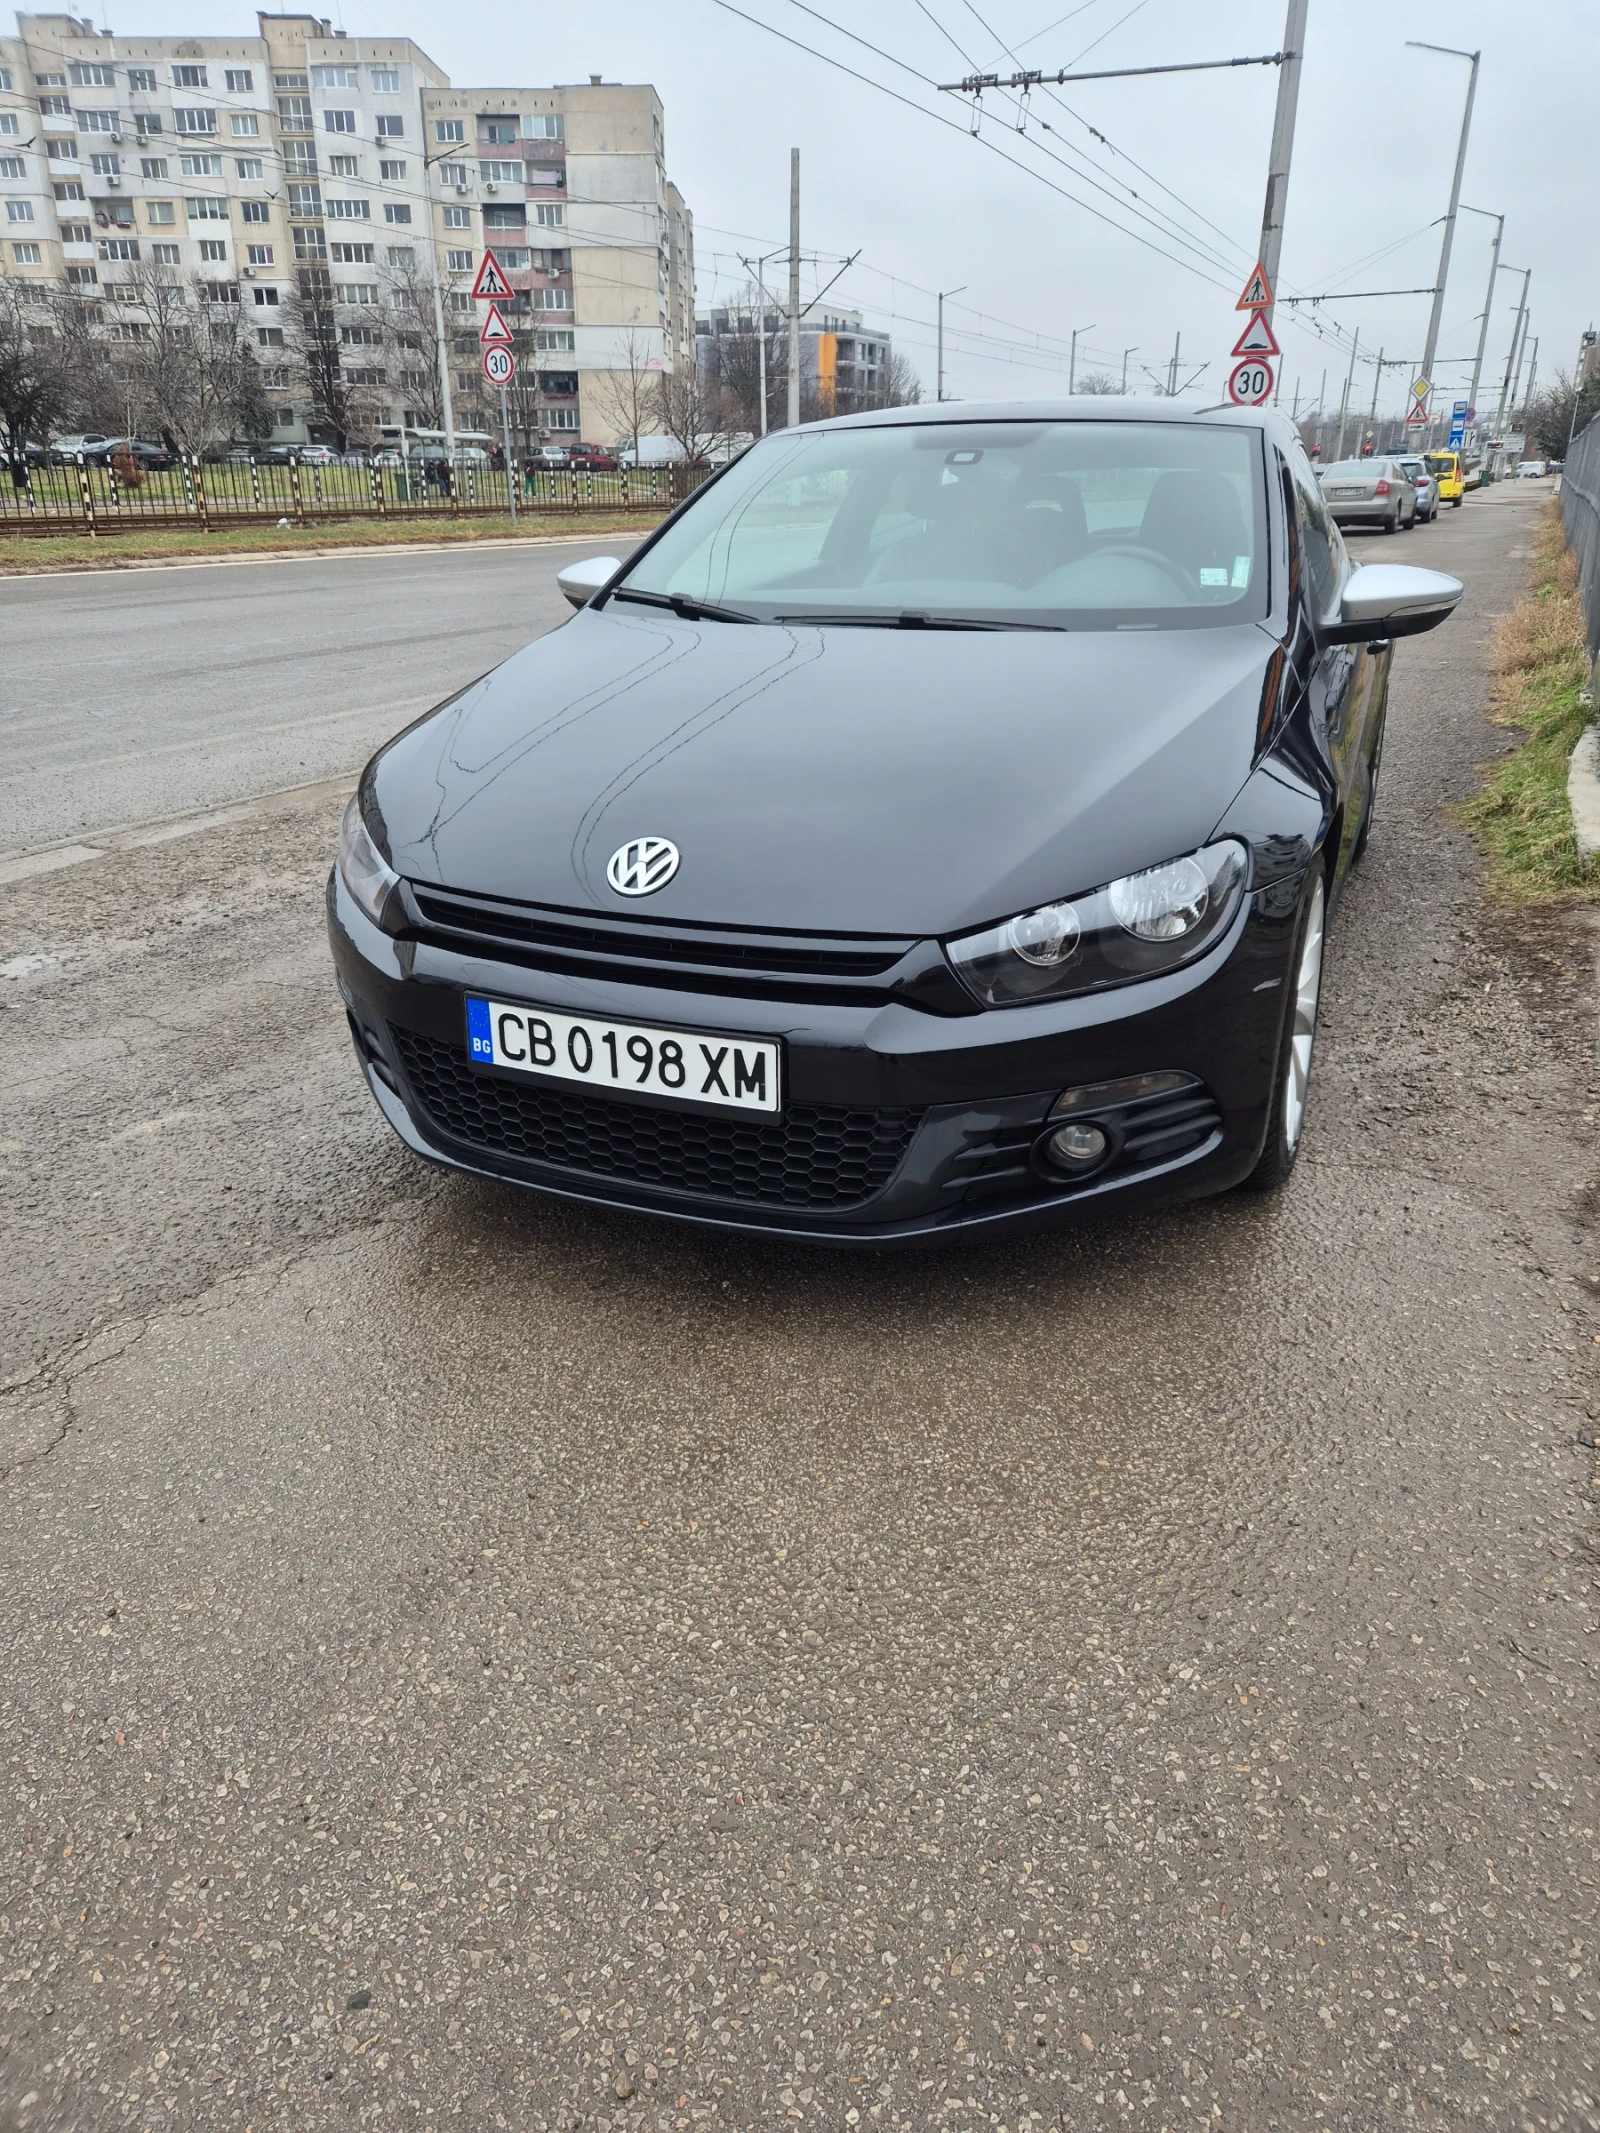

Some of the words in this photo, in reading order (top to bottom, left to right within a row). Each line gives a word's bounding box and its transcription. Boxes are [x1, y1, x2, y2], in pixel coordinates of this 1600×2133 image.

[490, 355, 508, 374] 30
[1238, 371, 1265, 394] 30
[472, 1037, 491, 1054] BG
[498, 1012, 556, 1067] CB
[568, 1025, 686, 1089] 0198
[699, 1043, 766, 1101] XM
